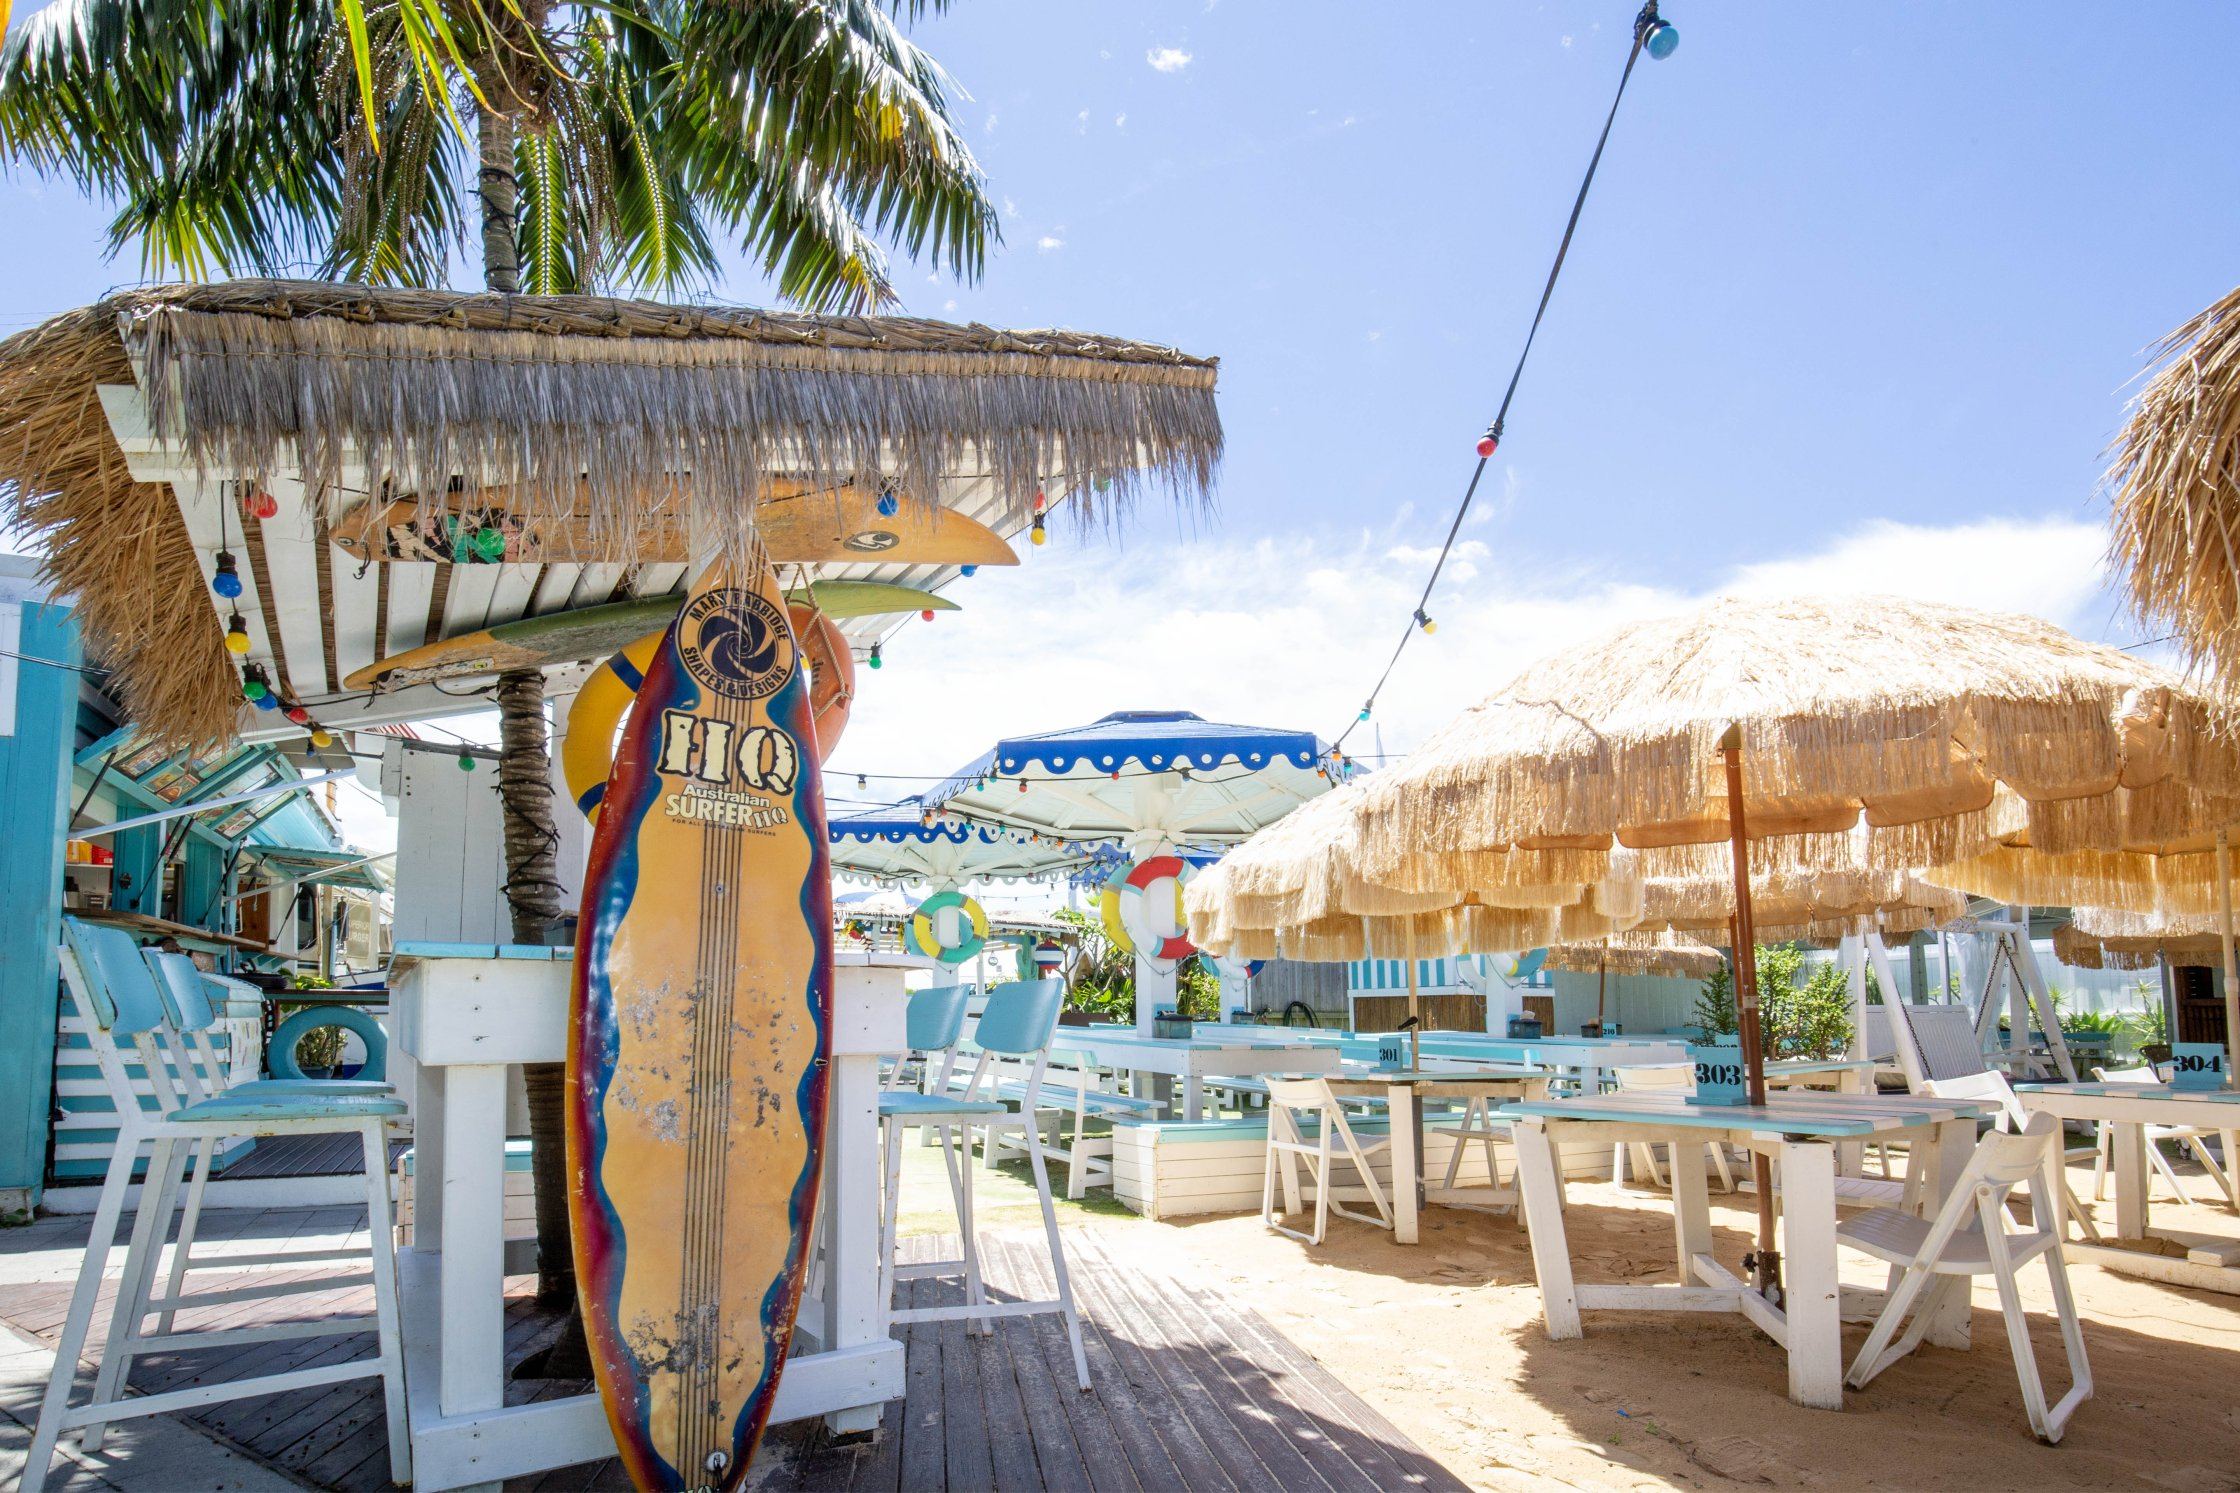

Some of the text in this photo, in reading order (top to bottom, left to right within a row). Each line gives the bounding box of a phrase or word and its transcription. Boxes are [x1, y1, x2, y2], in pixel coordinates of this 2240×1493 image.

[684, 646, 724, 690] SHAPES
[727, 682, 737, 696] &
[740, 665, 787, 697] DESIGNS
[657, 710, 793, 796] HQ
[682, 783, 770, 808] Australian
[665, 793, 788, 829] SURFER HQ
[747, 828, 776, 837] SURFERS
[1379, 1048, 1398, 1061] 301
[2172, 1055, 2222, 1072] 304
[1695, 1063, 1741, 1086] 303
